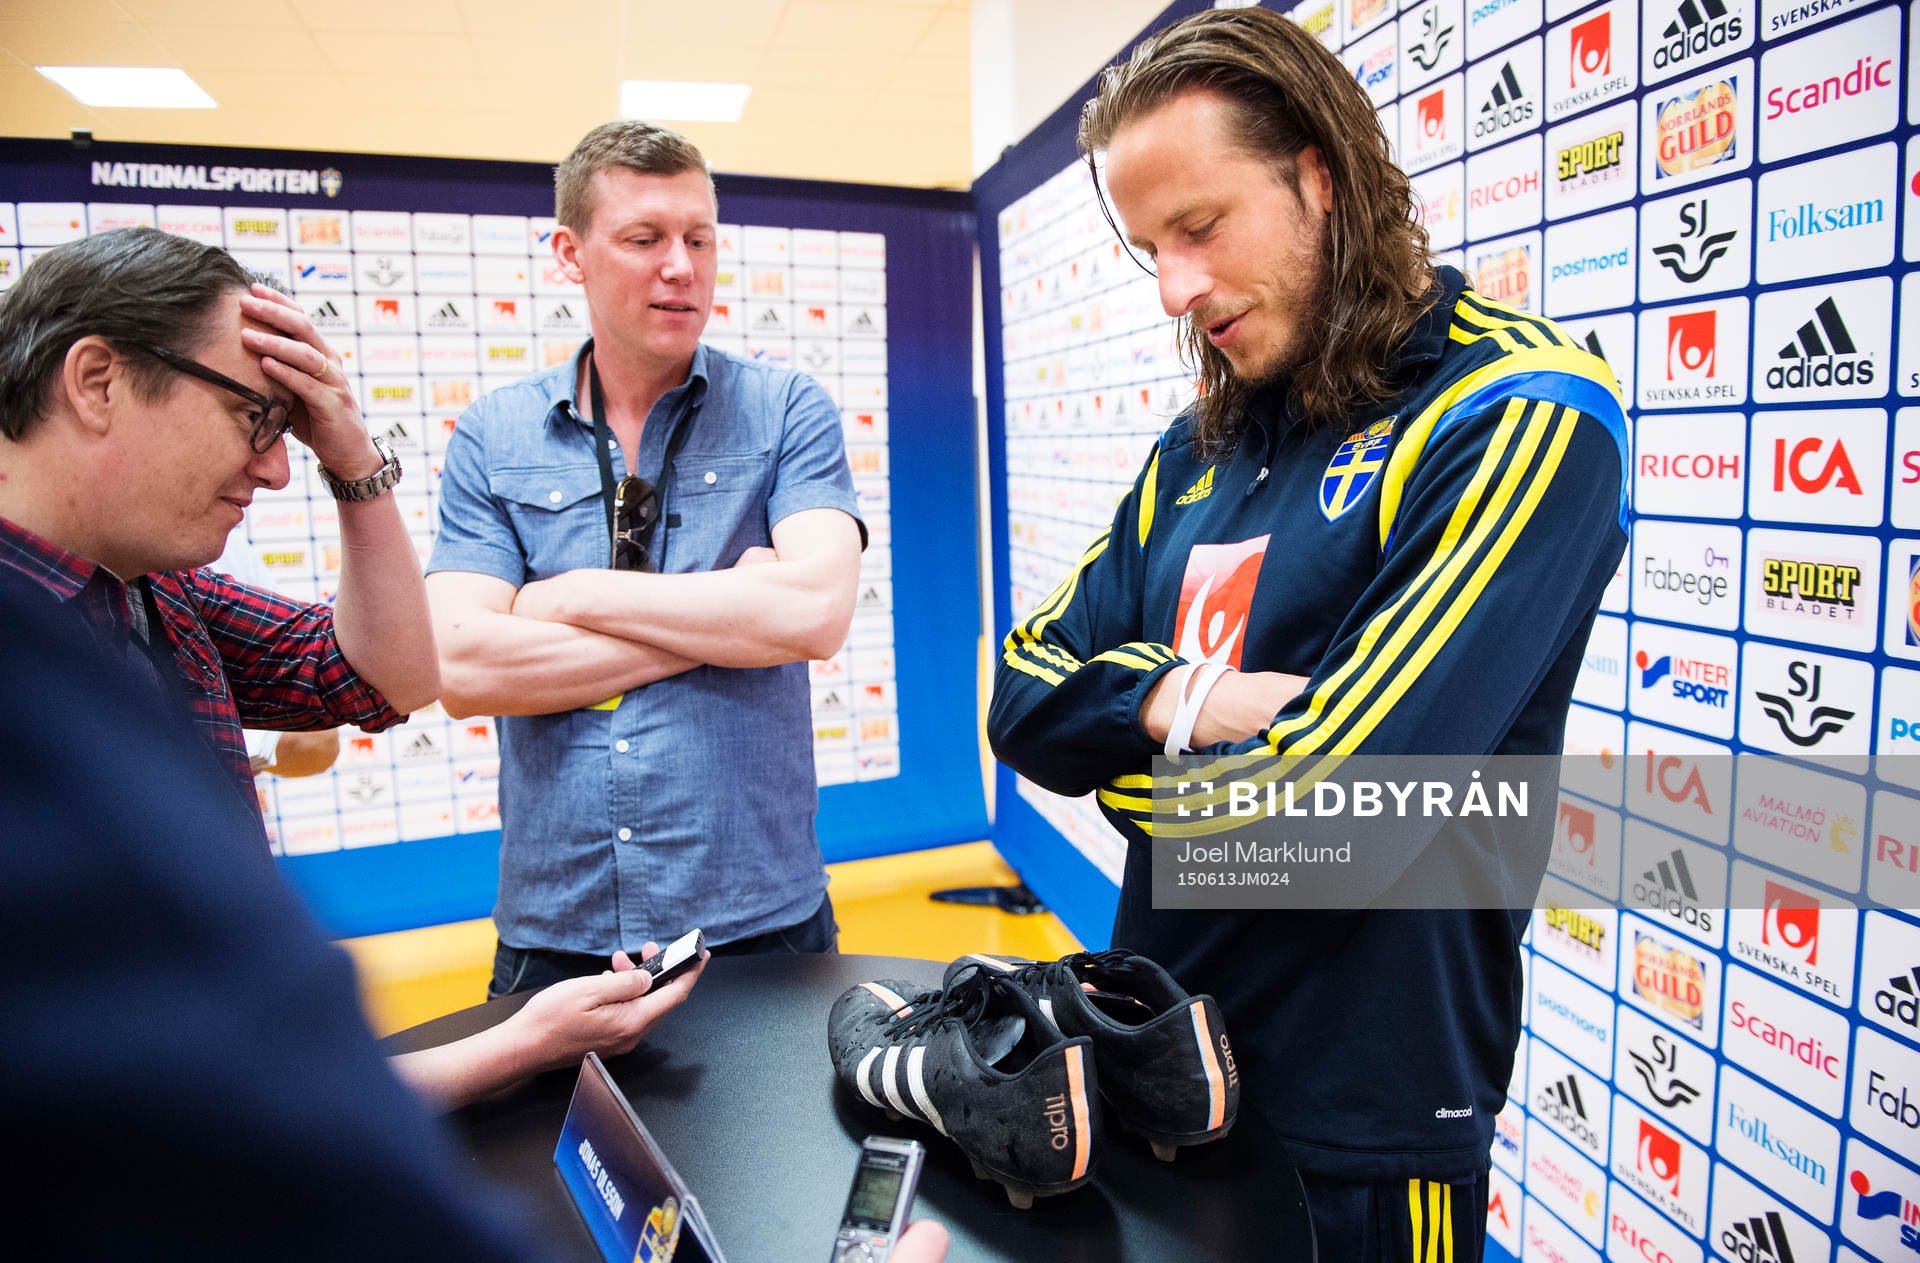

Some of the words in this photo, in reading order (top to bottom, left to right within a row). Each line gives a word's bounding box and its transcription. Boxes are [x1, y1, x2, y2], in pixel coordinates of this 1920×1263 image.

[1653, 16, 1743, 69] adidas
[1554, 86, 1599, 114] SVENSKA
[1603, 76, 1629, 96] SPEL
[1766, 56, 1893, 121] Scandic
[1474, 101, 1534, 138] adidas
[1660, 93, 1732, 133] NORRLANDS
[1659, 110, 1733, 161] GULD
[1557, 131, 1623, 182] SPORT
[91, 161, 319, 195] NATIONALSPORTEN
[1469, 171, 1539, 209] RICOH
[1560, 167, 1622, 192] BLADET
[1680, 199, 1708, 238] SJ
[1768, 198, 1885, 243] Folksam
[1552, 247, 1629, 281] postnord
[1766, 354, 1875, 390] adidas
[1646, 389, 1700, 402] SVENSKA
[1706, 385, 1736, 398] SPEL
[1640, 454, 1740, 479] RICOH
[1773, 437, 1864, 495] ICA
[1644, 556, 1728, 606] Fabege
[1763, 558, 1859, 607] SPORT
[1766, 599, 1855, 620] BLADET
[1673, 656, 1729, 687] INTER
[1787, 661, 1821, 702] SJ
[1672, 680, 1729, 709] SPORT
[1645, 749, 1713, 815] ICA
[1742, 808, 1822, 844] AVIATION
[1758, 794, 1826, 827] MALMÖ
[1632, 884, 1713, 933] adidas
[1635, 965, 1702, 1007] GULD
[1738, 941, 1799, 979] SVENSKA
[1805, 972, 1841, 999] SPEL
[1652, 1034, 1676, 1072] SJ
[1730, 1001, 1840, 1080] Scandic
[1536, 1094, 1599, 1151] adidas
[1728, 1101, 1826, 1187] Folksam
[578, 1138, 602, 1179] JONAS
[596, 1168, 626, 1222] OLSSON
